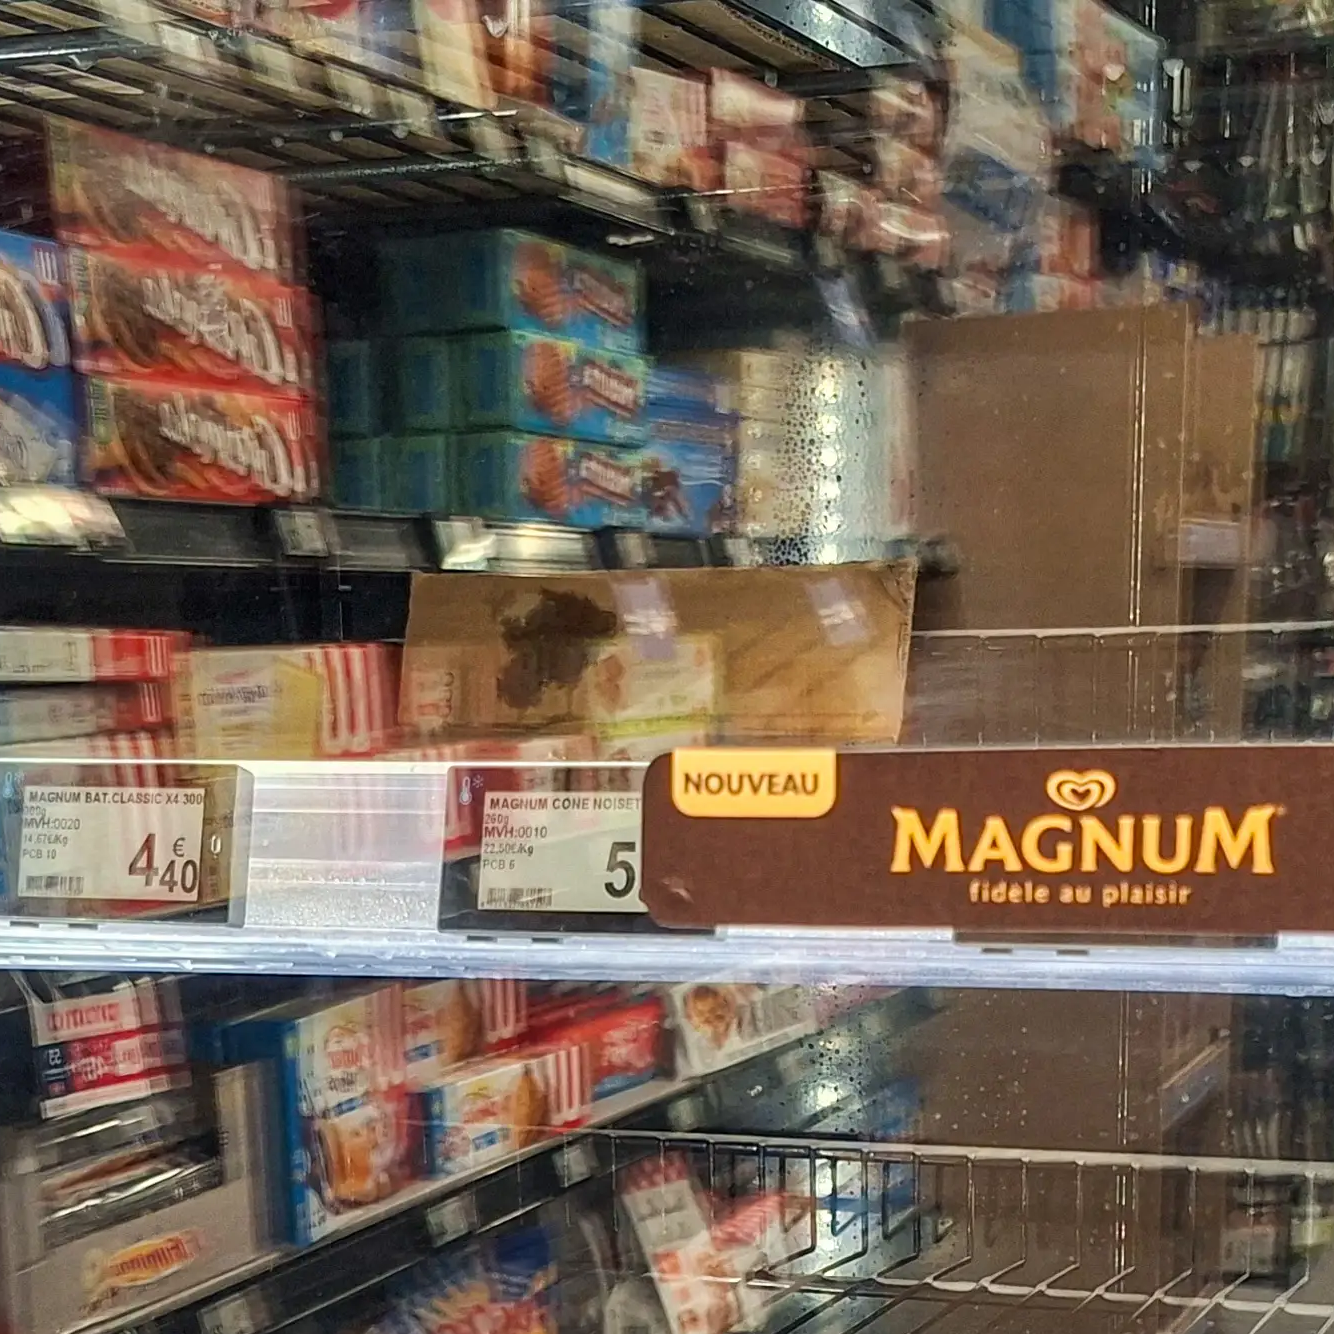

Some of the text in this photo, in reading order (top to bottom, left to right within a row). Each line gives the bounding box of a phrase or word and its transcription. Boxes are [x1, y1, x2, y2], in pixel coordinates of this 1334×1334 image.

[683, 771, 820, 797] NOUVEAU
[29, 791, 203, 805] MAGNUM BAT.CLASSIC X4 300
[489, 798, 548, 810] MAGNUM
[552, 798, 590, 810] CONE
[484, 826, 548, 839] MVH:0010
[890, 804, 1276, 874] MAGNUM
[22, 848, 57, 859] PCB 10
[128, 833, 199, 894] 4 € 40
[483, 859, 505, 870] PCB
[604, 842, 637, 899] 5
[970, 879, 1192, 908] fidèle au plaisir
